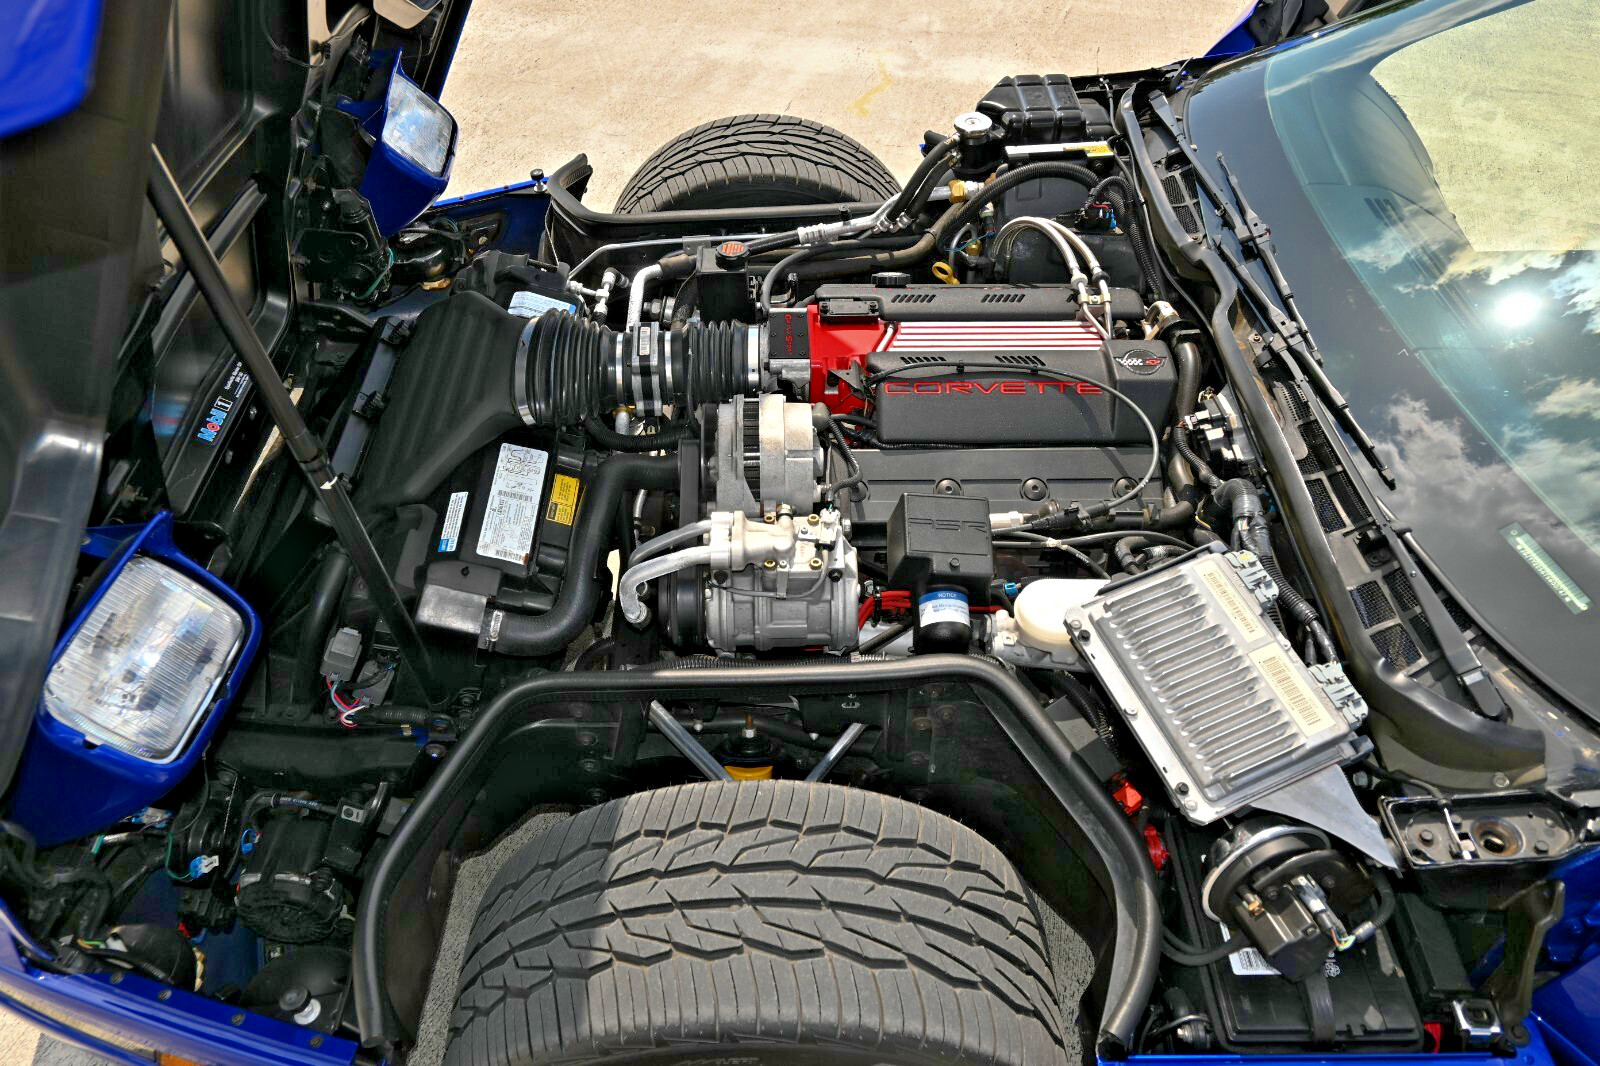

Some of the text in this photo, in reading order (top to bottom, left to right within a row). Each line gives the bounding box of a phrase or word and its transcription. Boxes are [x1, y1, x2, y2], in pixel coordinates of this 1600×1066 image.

[884, 381, 1103, 395] CORVETTE
[197, 408, 228, 442] Mobil
[908, 517, 987, 533] ASR
